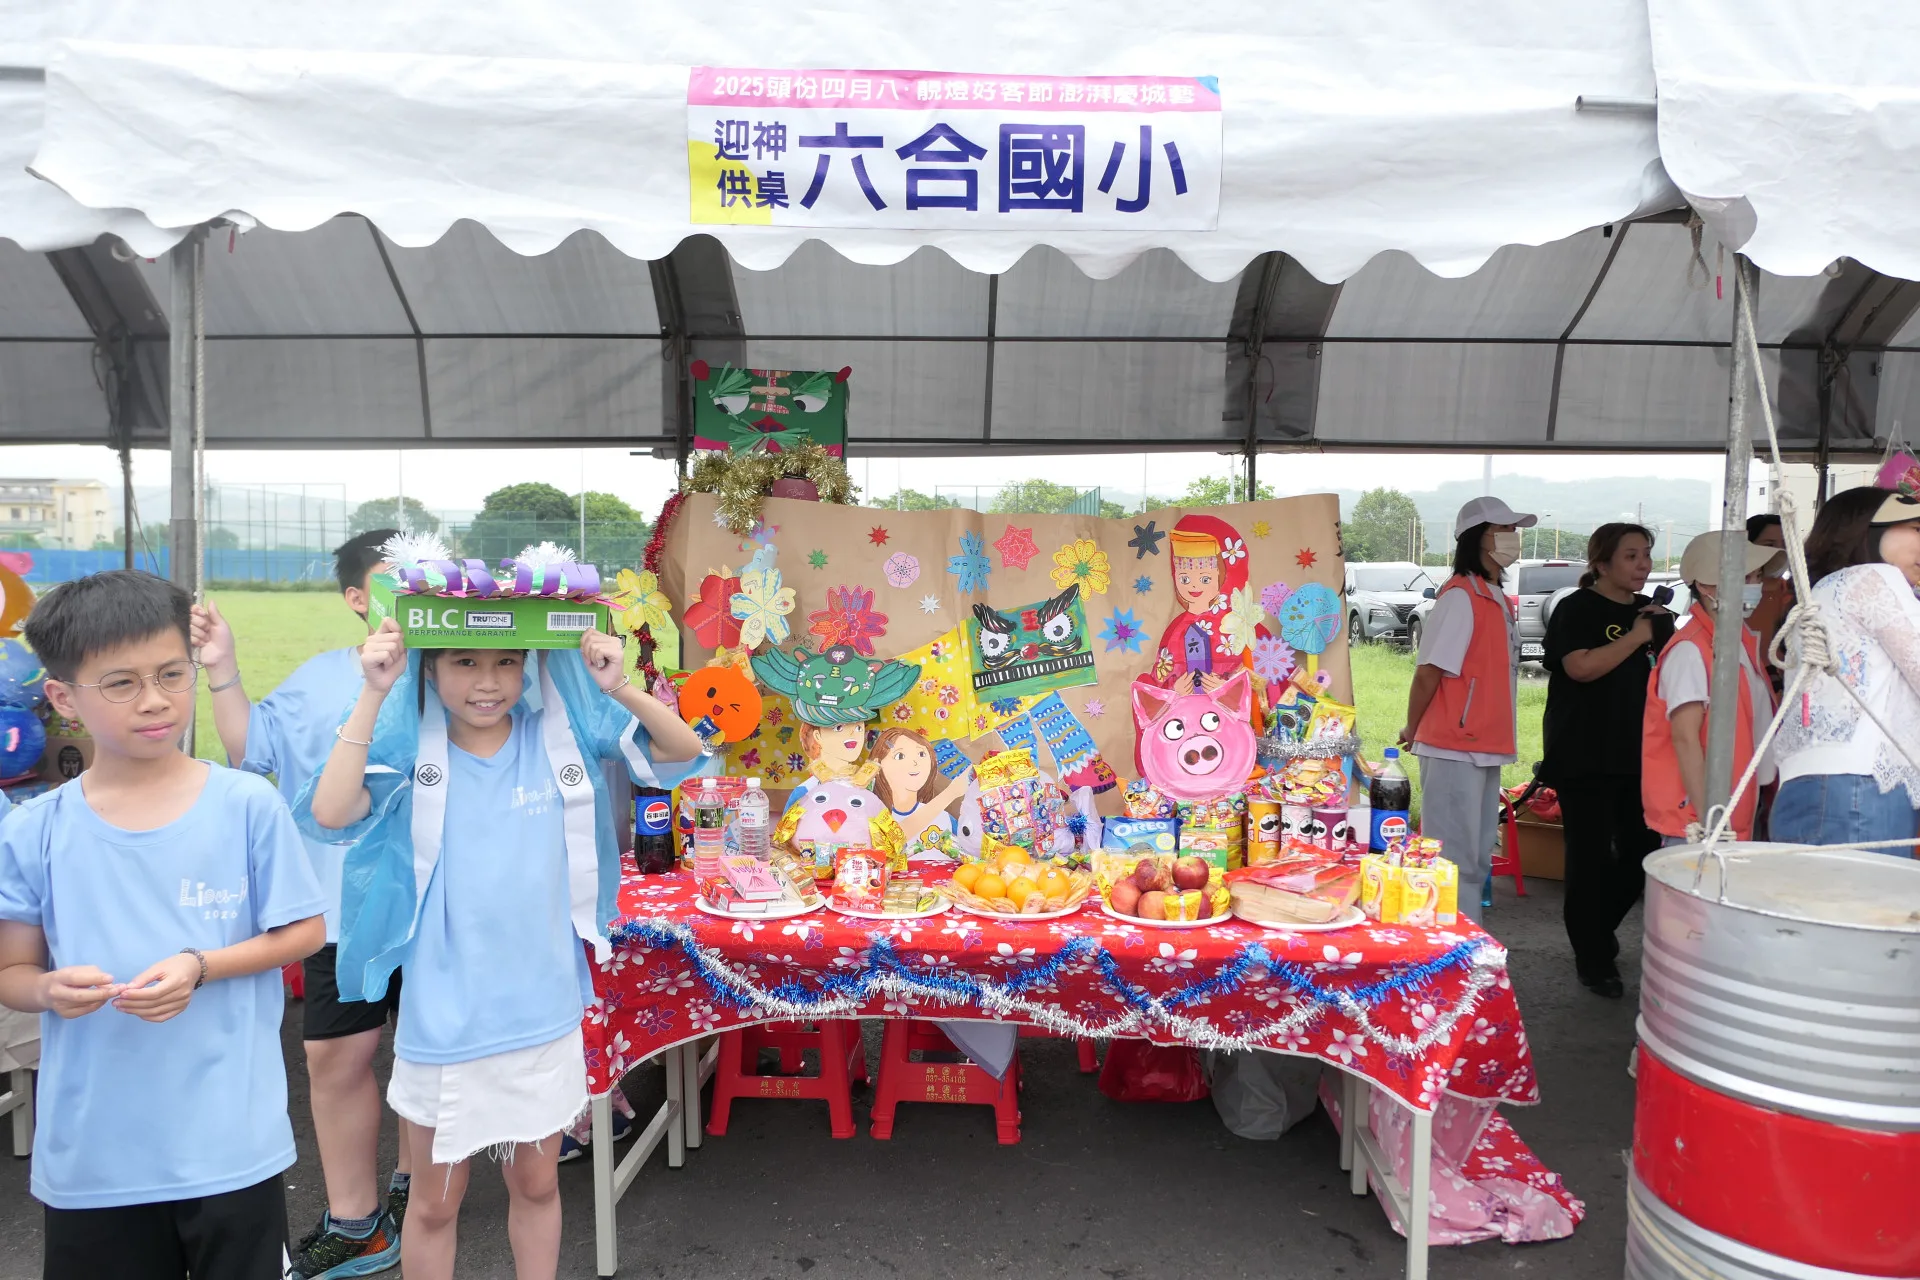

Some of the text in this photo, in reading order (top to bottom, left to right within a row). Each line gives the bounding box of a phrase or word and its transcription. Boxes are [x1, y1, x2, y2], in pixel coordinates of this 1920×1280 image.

[714, 119, 788, 161] 迎神
[799, 121, 1188, 214] 六合國小
[716, 169, 790, 210] 供桌
[408, 608, 459, 629] BLC
[472, 615, 508, 623] TRUTONE
[408, 629, 472, 637] PERFORMANCE
[1113, 821, 1167, 837] OREO
